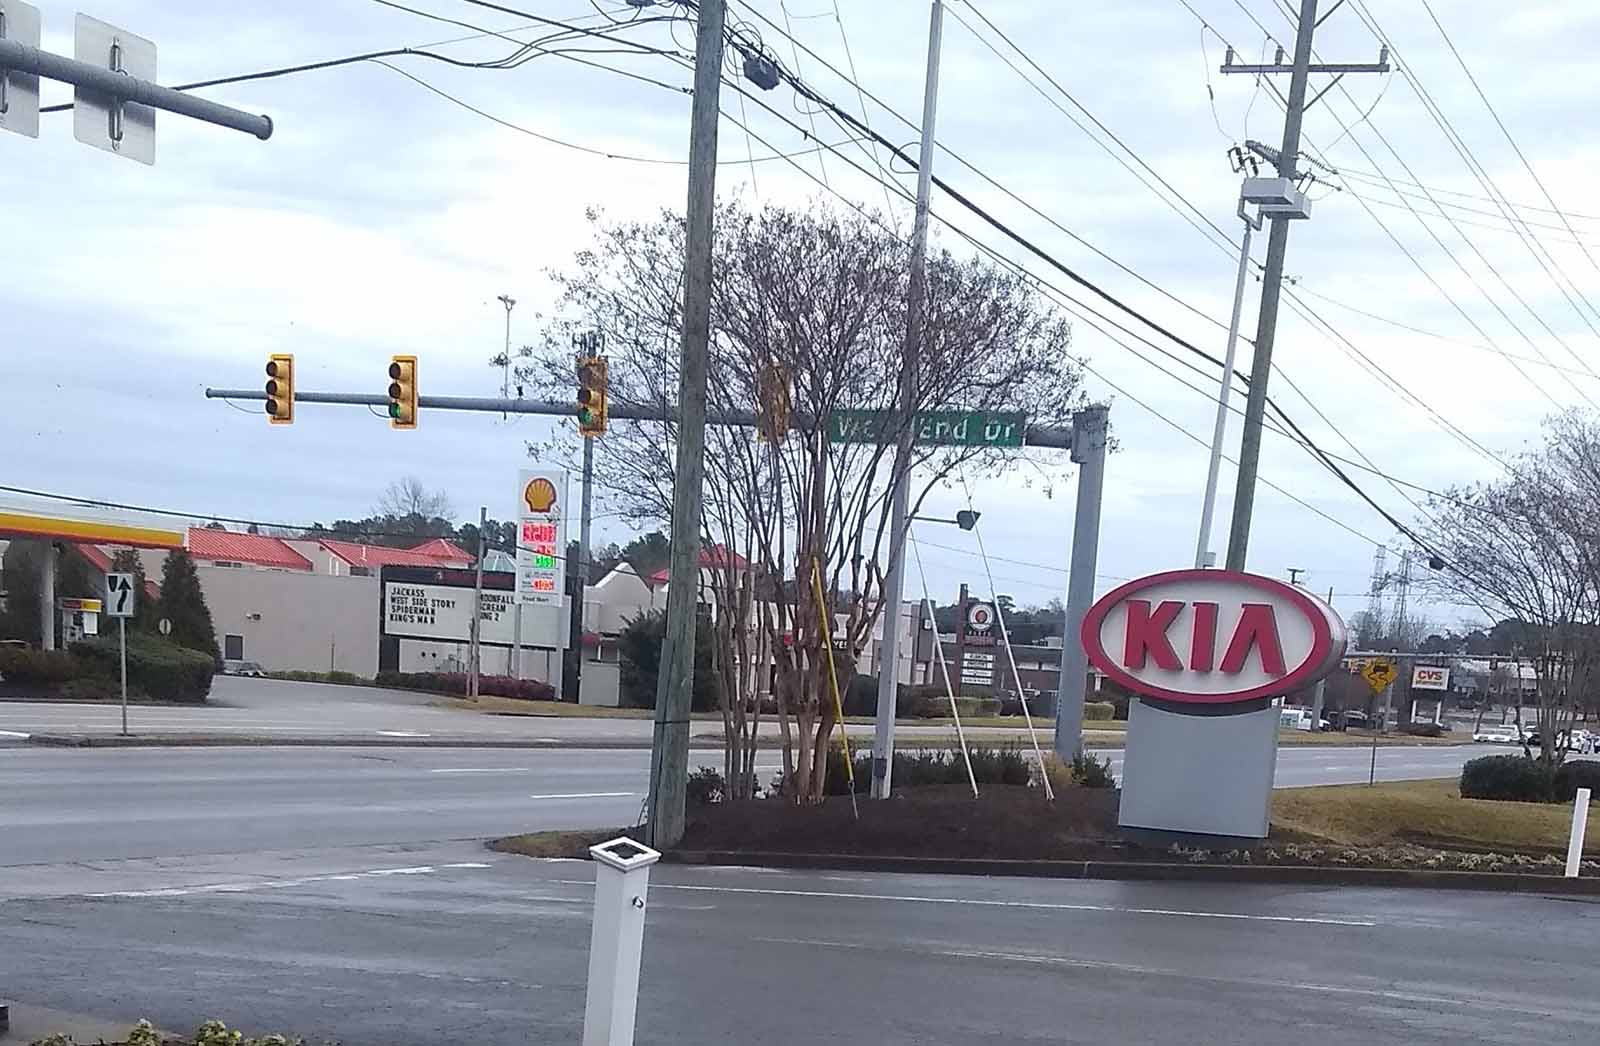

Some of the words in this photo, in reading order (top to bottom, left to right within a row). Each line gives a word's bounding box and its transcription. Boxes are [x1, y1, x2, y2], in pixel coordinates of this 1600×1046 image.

[391, 587, 425, 597] JACKASS
[391, 596, 408, 605] WEST
[412, 597, 428, 606] SIDE
[431, 599, 456, 608] STORY
[391, 605, 436, 615] SPIDERMAN
[1123, 600, 1287, 676] KIA
[1418, 671, 1442, 680] CVS
